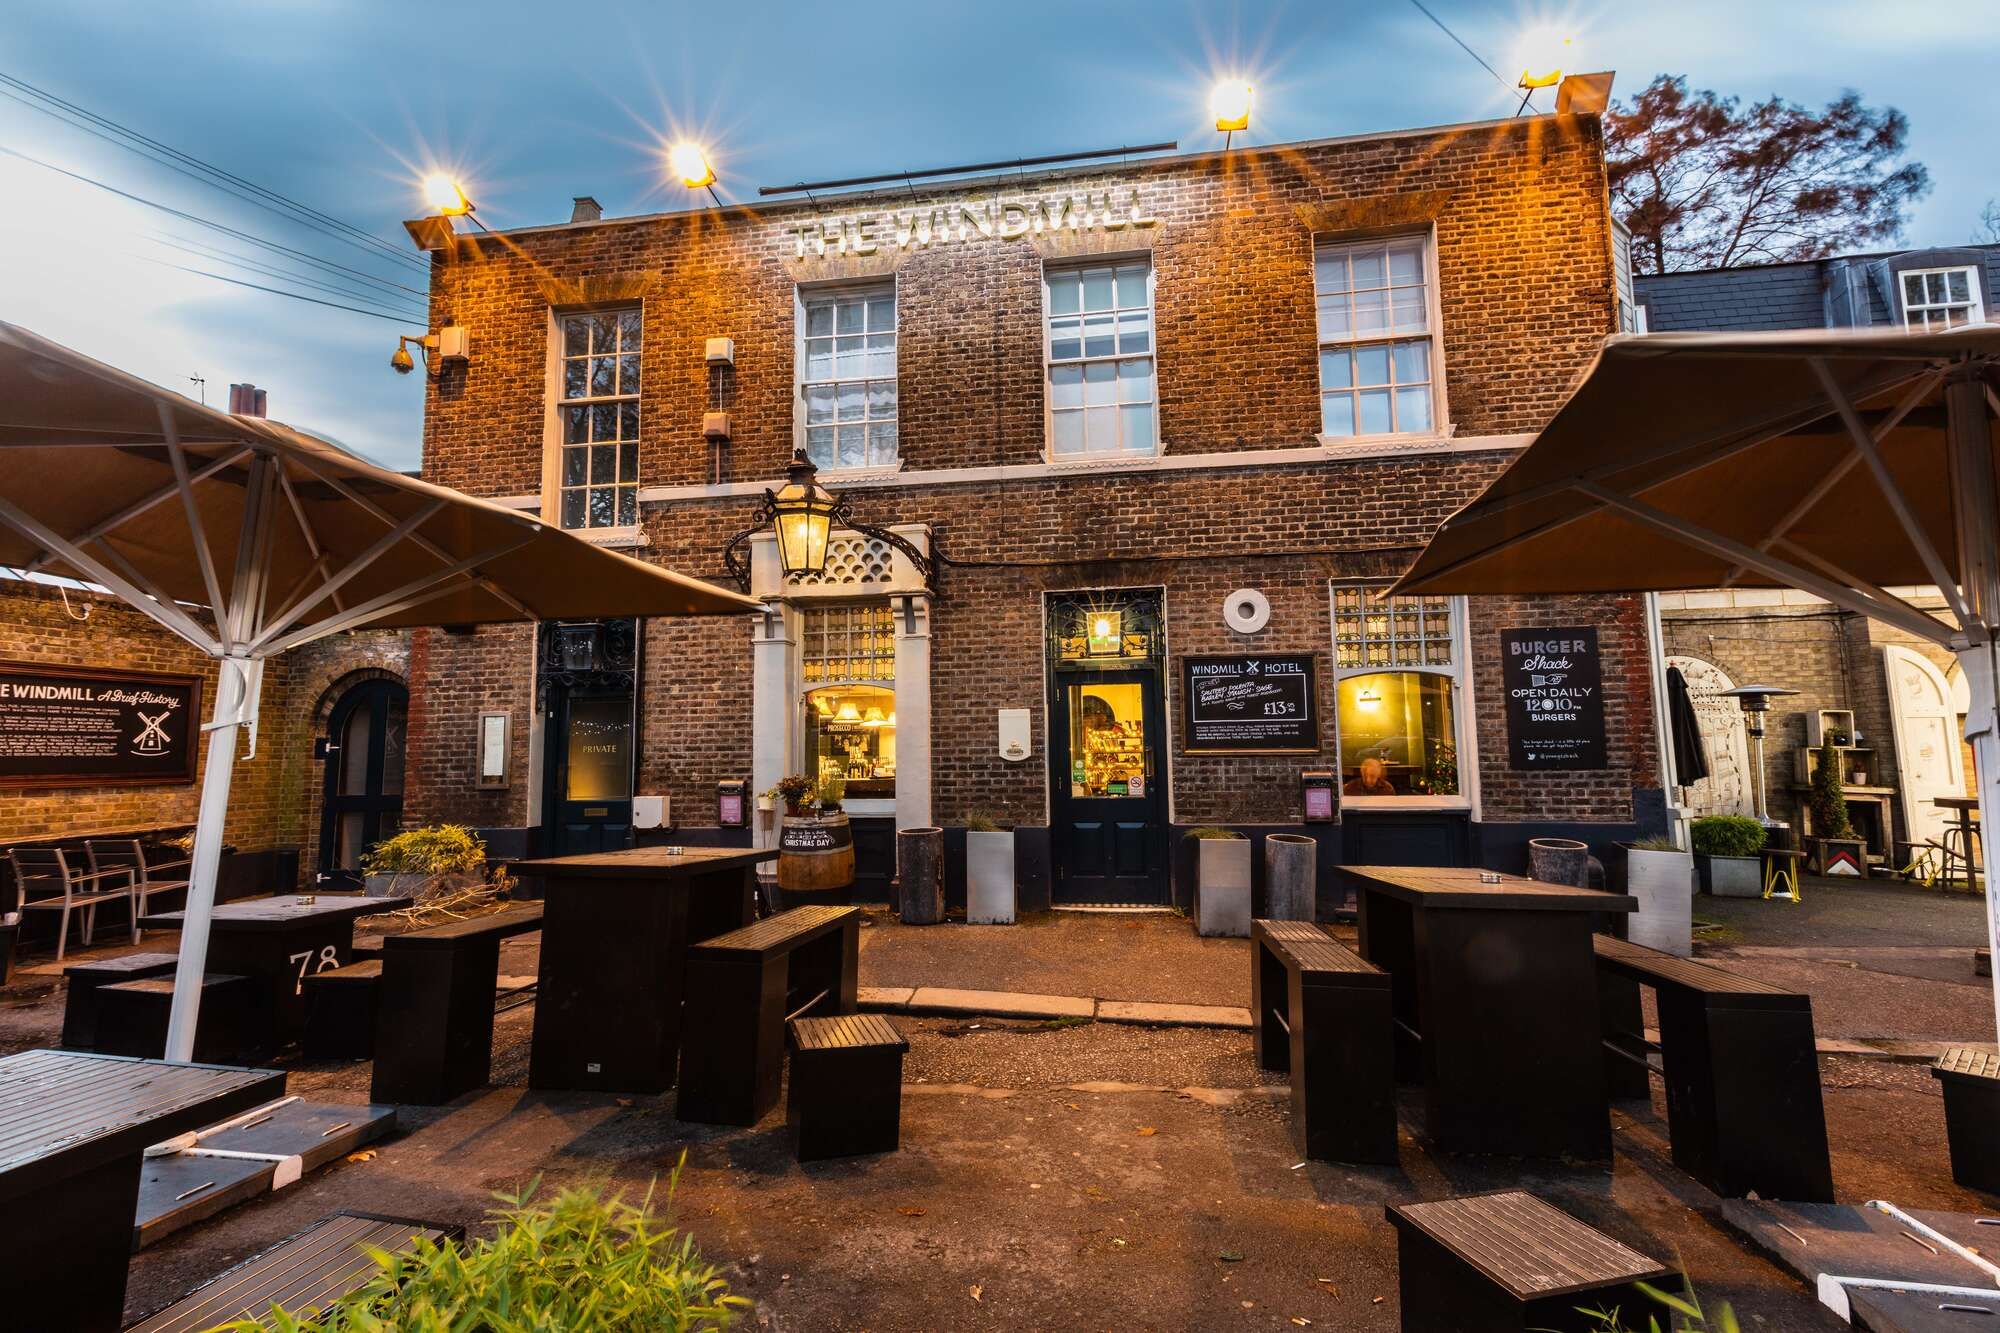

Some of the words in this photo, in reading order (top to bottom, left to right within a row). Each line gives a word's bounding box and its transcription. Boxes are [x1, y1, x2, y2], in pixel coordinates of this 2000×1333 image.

[788, 218, 878, 262] THE
[893, 189, 1156, 250] WINDMILL
[1510, 640, 1586, 655] BURGER
[1192, 664, 1243, 674] WINDMILL
[1265, 663, 1303, 673] HOTEL
[1520, 654, 1573, 671] Shack
[12, 684, 94, 700] WINDMILL
[97, 690, 112, 701] A
[110, 689, 140, 706] Brief
[138, 691, 181, 709] History
[1511, 689, 1546, 698] OPEN
[1550, 687, 1592, 697] DAILY
[1531, 713, 1576, 721] BURGERS
[582, 744, 617, 753] PRIVATE
[785, 839, 814, 847] CHRISTMAS
[816, 839, 830, 847] DAY
[289, 945, 340, 995] 78
